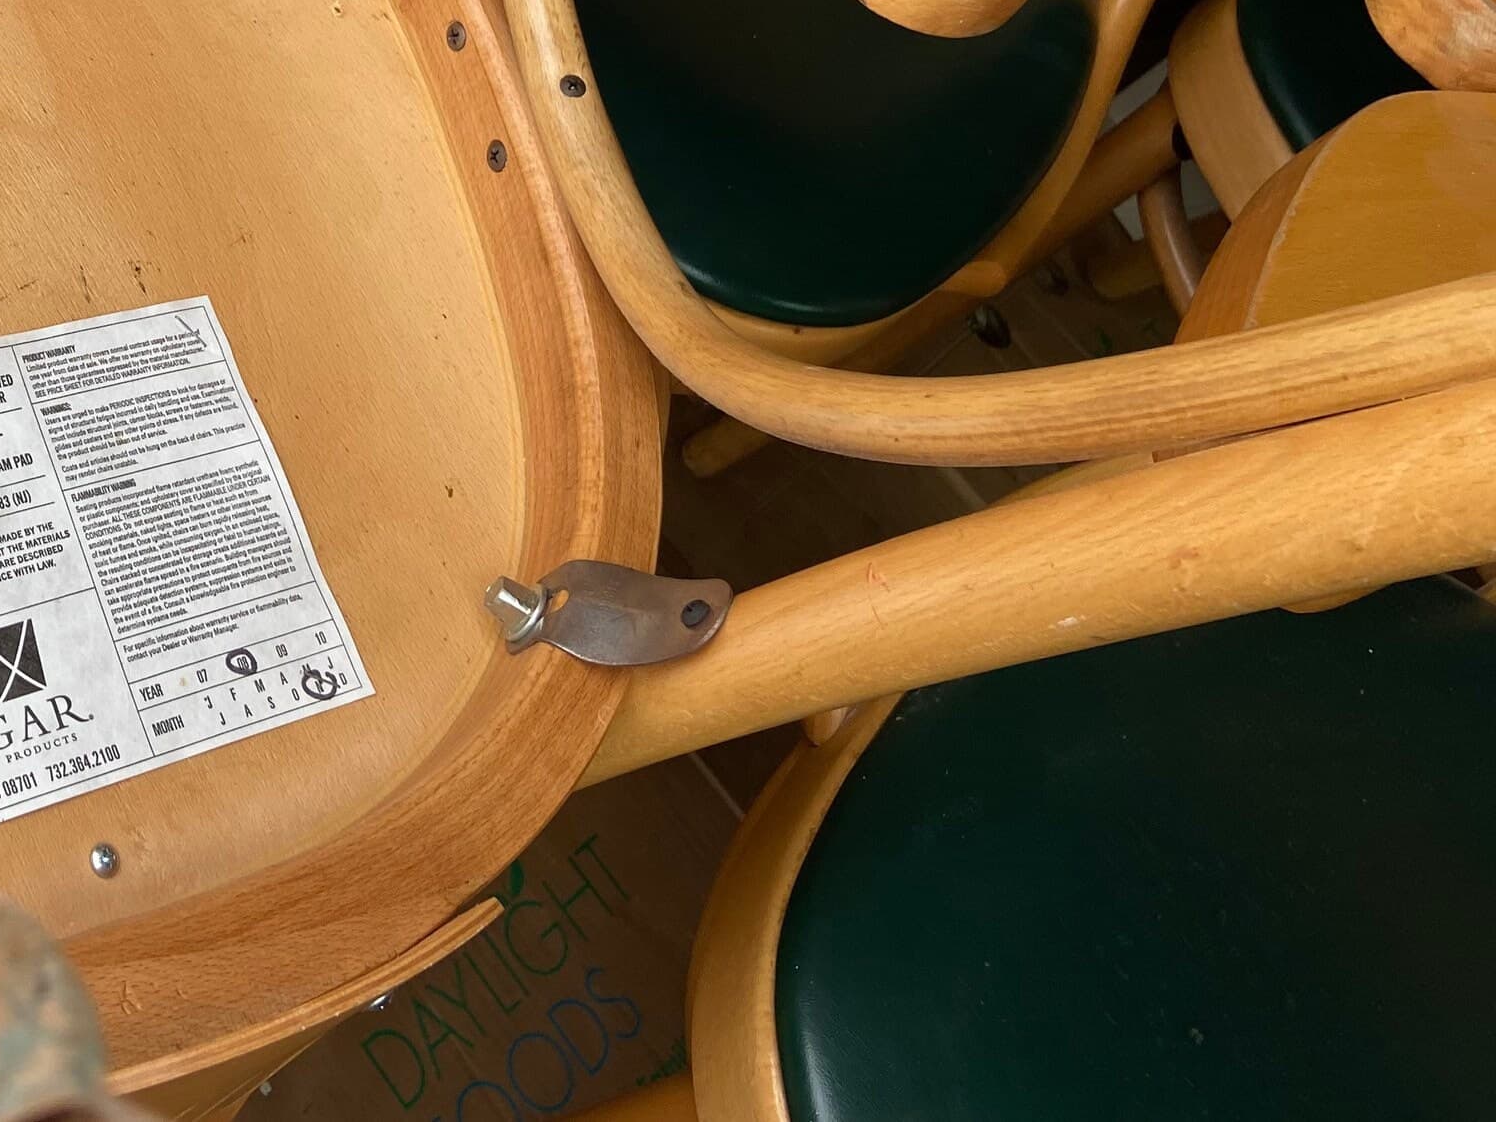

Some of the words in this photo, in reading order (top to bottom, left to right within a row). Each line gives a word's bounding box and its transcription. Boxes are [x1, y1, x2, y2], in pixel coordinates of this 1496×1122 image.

[12, 452, 33, 468] PAD
[12, 489, 31, 507] (NJ)
[6, 542, 24, 554] THE
[24, 529, 70, 549] MATERIALS
[23, 526, 35, 536] BY
[36, 521, 54, 533] THE
[0, 557, 16, 569] ARE
[16, 544, 63, 564] DESCRIBED
[12, 564, 35, 577] WITH
[36, 558, 56, 571] LAW.
[139, 683, 164, 702] YEAR
[196, 668, 208, 683] 07
[236, 656, 249, 670] 08
[275, 643, 288, 658] 09
[315, 631, 327, 645] 10
[206, 695, 213, 709] J
[229, 687, 236, 701] F
[254, 678, 265, 693] M
[279, 671, 288, 685] A
[328, 657, 334, 669] J
[219, 712, 226, 725] J
[244, 704, 253, 718] A
[267, 696, 275, 709] S
[291, 688, 300, 701] O
[338, 672, 347, 685] D
[151, 714, 184, 737] MONTH
[5, 732, 77, 763] PRODUCTS
[2, 771, 37, 796] 08701
[45, 744, 120, 782] 732.364.2100
[360, 833, 632, 1110] DAYLIGHT
[433, 968, 641, 1122] OODS
